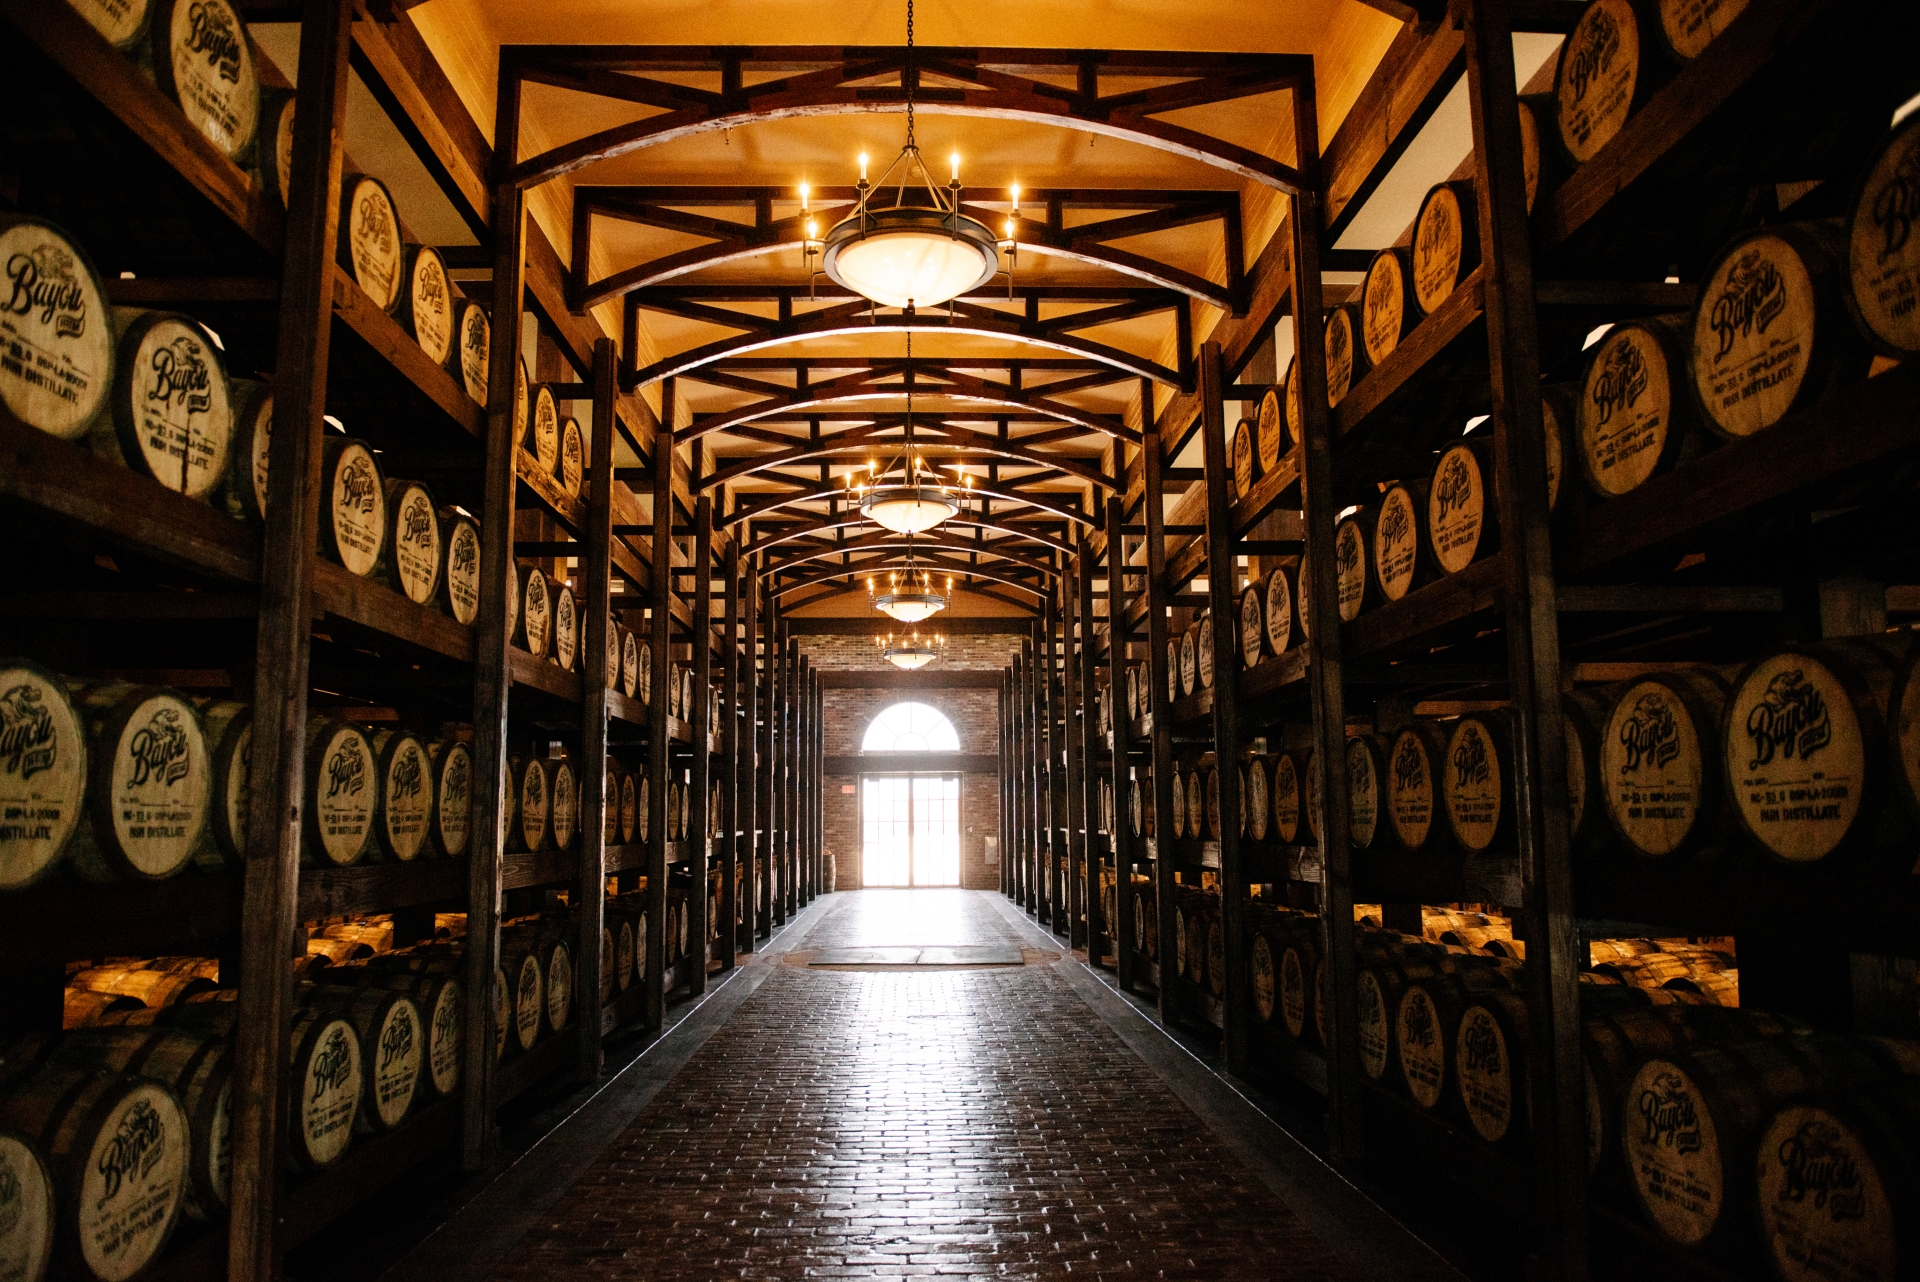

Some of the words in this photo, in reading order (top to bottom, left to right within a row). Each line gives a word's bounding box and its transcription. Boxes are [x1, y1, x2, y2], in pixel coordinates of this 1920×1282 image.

[1, 253, 83, 325] Bayou
[1711, 263, 1775, 365] Bayou
[25, 367, 79, 406] DISTILLATE
[148, 347, 208, 406] Bayou
[1741, 363, 1794, 401] DISTILLATE
[0, 714, 52, 774] ayou
[127, 728, 187, 790] Bayou
[1620, 711, 1674, 775] Bayou
[1747, 690, 1824, 771] Bayou
[1783, 802, 1841, 821] DISTILLATE
[1640, 1089, 1696, 1147] Bayou
[1778, 1137, 1857, 1210] Bayou
